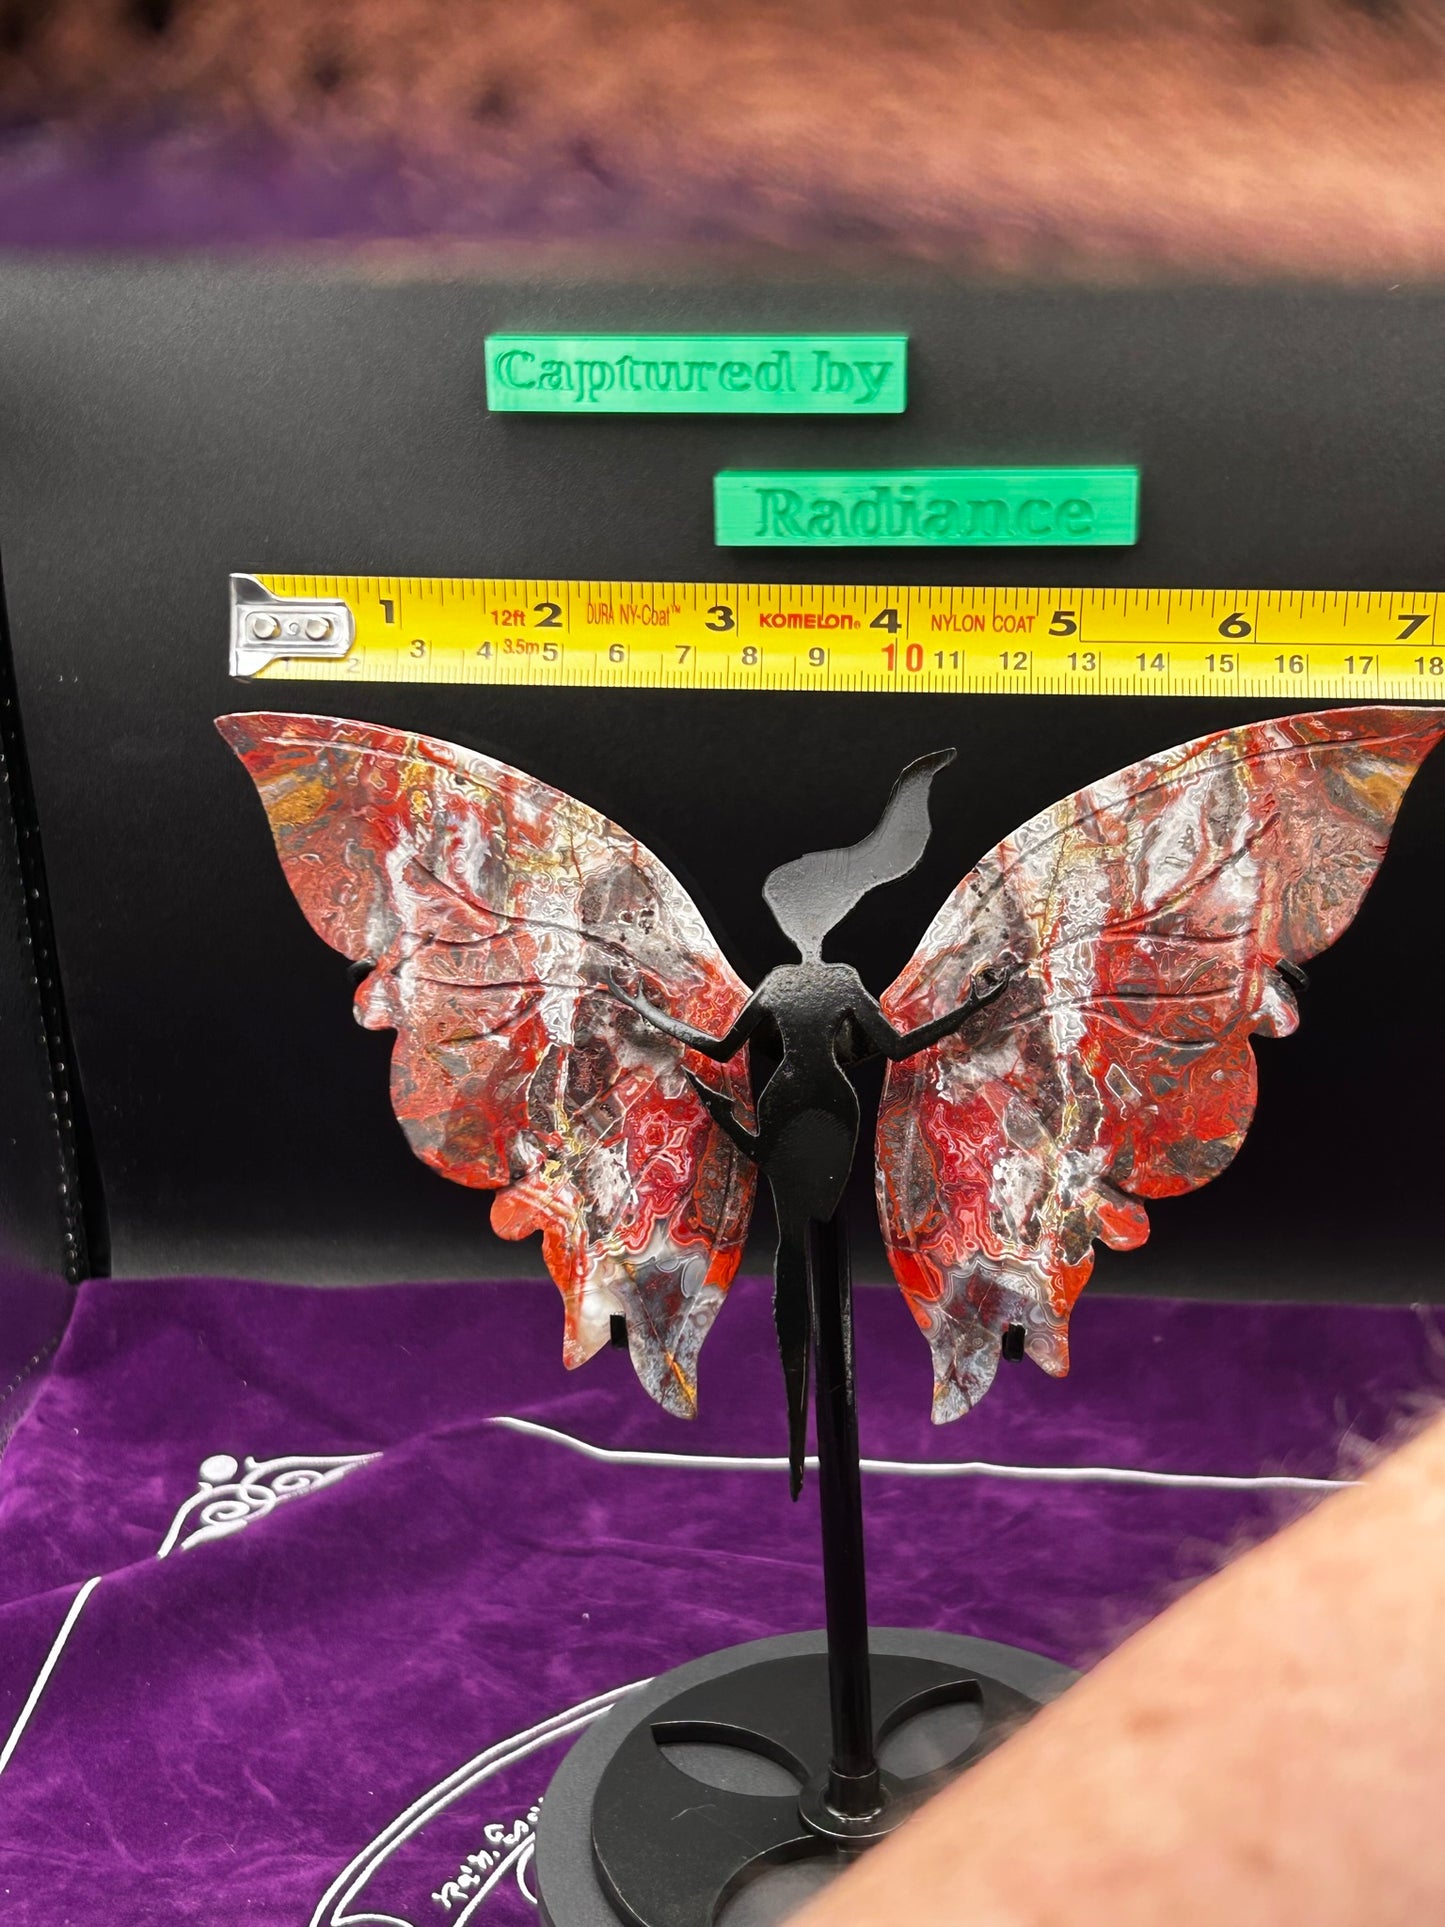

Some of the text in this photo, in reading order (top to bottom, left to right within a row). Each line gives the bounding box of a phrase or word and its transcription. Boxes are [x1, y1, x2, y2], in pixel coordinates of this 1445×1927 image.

[496, 350, 894, 404] Captured by
[755, 485, 1096, 538] Radiance
[379, 599, 395, 624] 1
[491, 609, 526, 627] 12ft
[533, 602, 563, 628] 2
[587, 603, 614, 625] DURA
[705, 605, 735, 632] 3
[869, 608, 902, 634] 4
[931, 614, 1036, 633] NYLON COAT
[1048, 610, 1078, 637] 5
[1218, 612, 1252, 639] 6
[1395, 614, 1431, 640] 7
[410, 639, 426, 658] 3
[477, 641, 493, 660] 4
[503, 638, 540, 655] 3.5m
[542, 642, 558, 661] 5
[609, 643, 625, 663] 6
[675, 645, 692, 664] 7
[741, 646, 758, 666] 8
[346, 658, 361, 673] 2
[808, 647, 825, 667] 9
[881, 643, 924, 672] 10
[934, 650, 959, 669] 11
[999, 651, 1028, 671] 12
[1067, 652, 1096, 672] 13
[1136, 653, 1165, 672] 14
[1205, 654, 1234, 673] 15
[1274, 654, 1304, 674] 16
[1344, 655, 1374, 675] 17
[1414, 656, 1444, 676] 18
